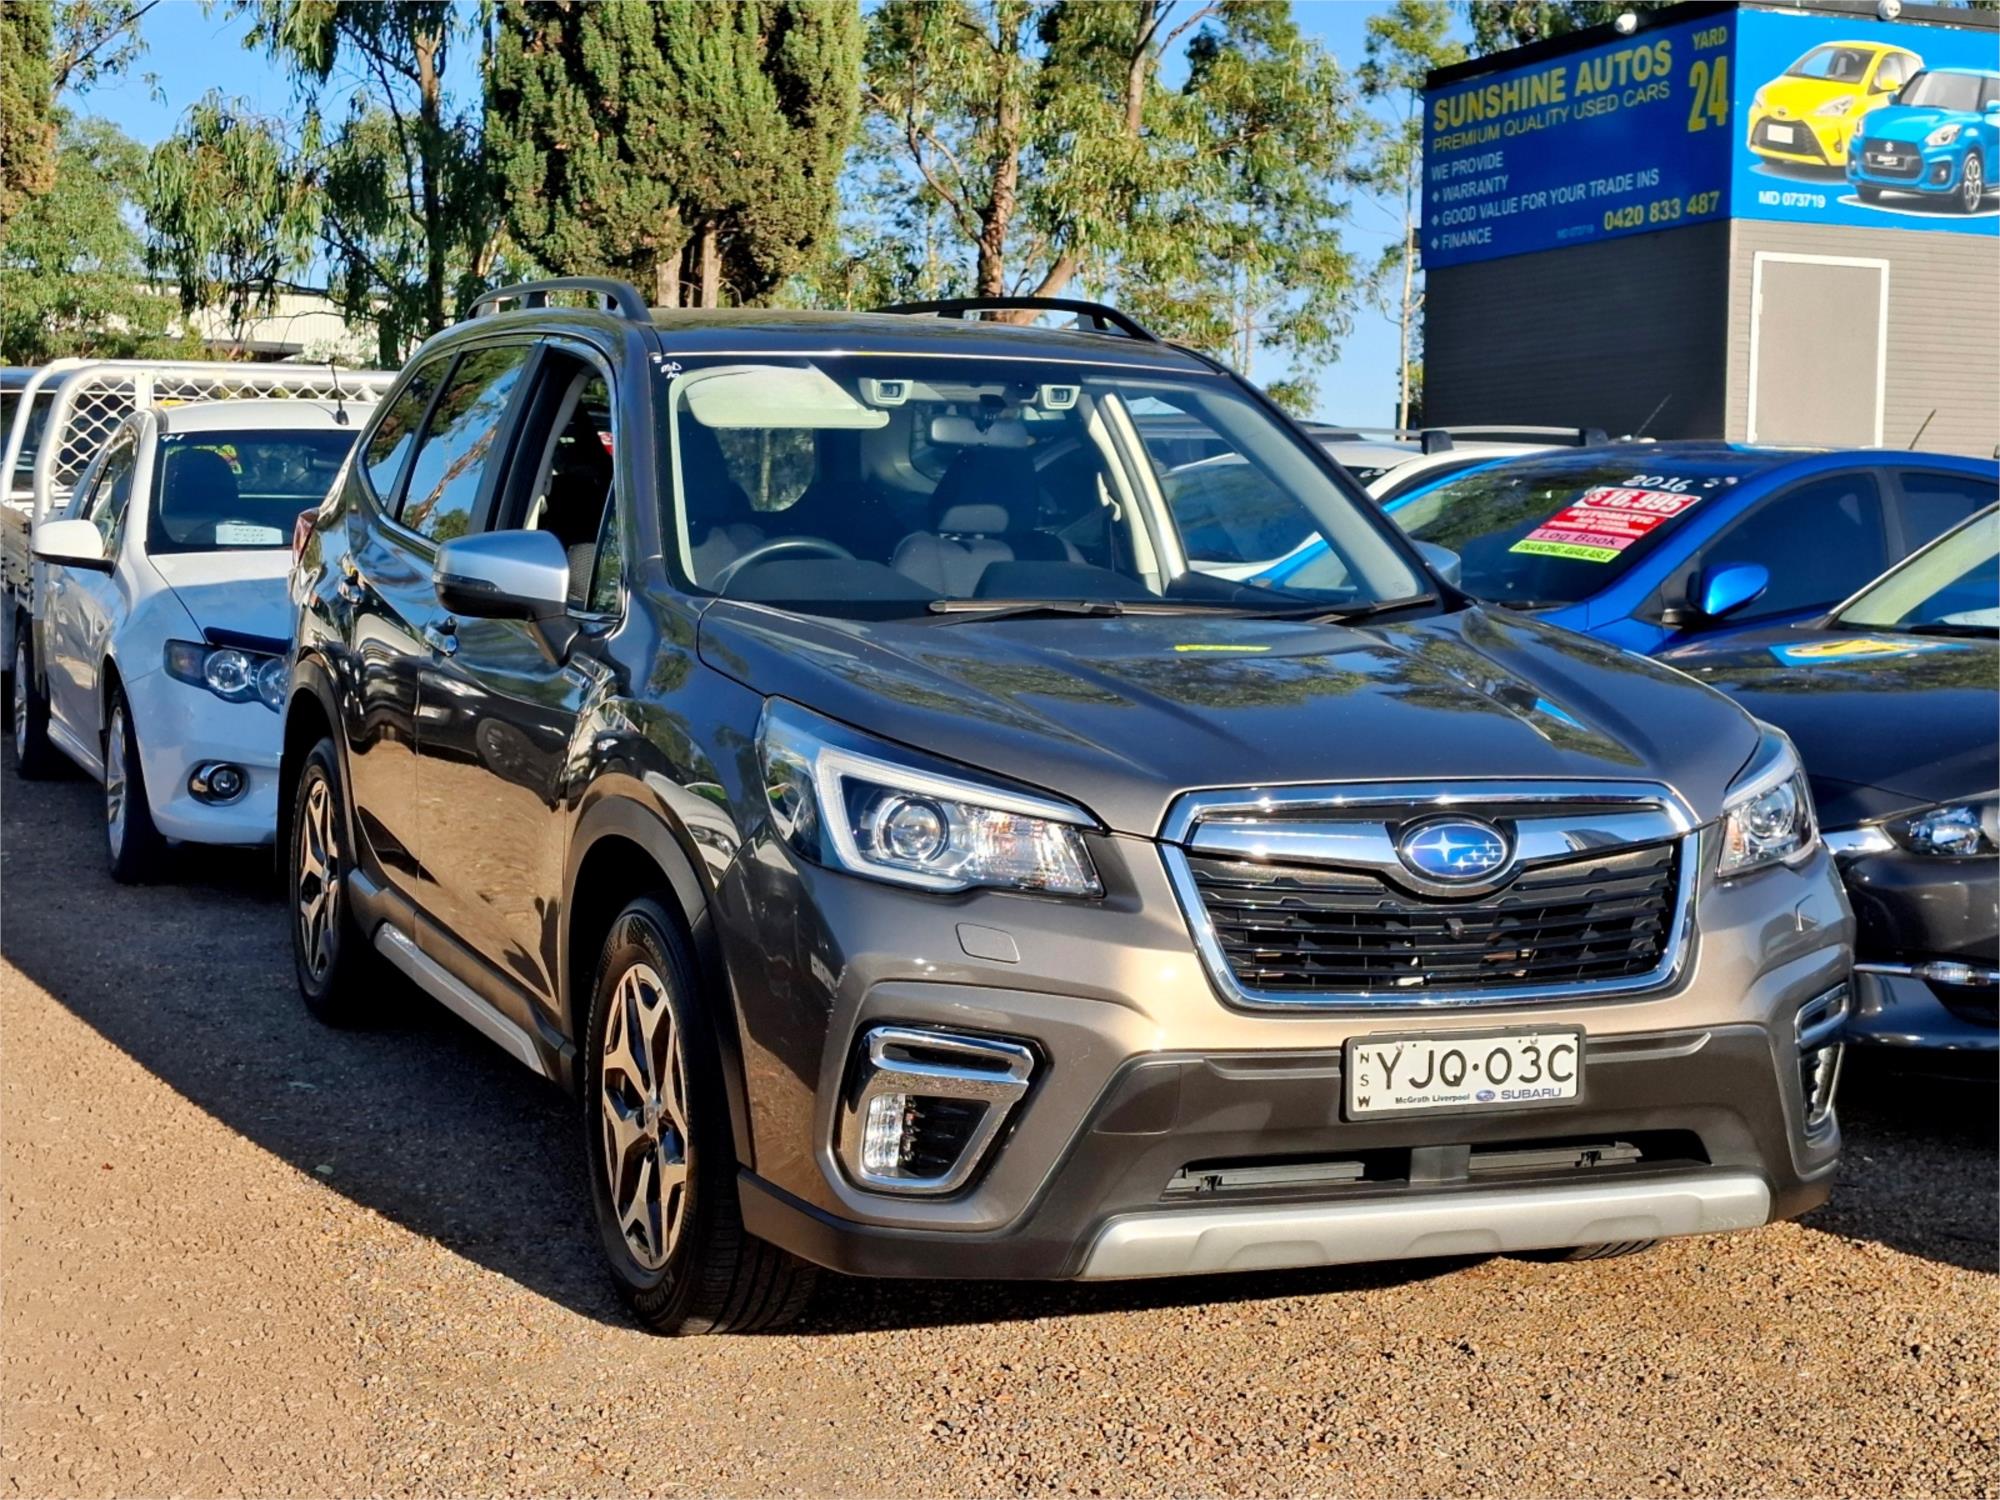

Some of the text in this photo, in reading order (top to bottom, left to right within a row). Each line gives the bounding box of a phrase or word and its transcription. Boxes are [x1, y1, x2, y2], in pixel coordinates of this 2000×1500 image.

[1692, 26, 1728, 50] YARD
[1433, 40, 1672, 132] SUNSHINE AUTOS
[1688, 56, 1729, 133] 24
[1432, 81, 1671, 153] PREMIUM QUALITY USED CARS
[1431, 151, 1504, 181] WE PROVIDE
[1442, 174, 1509, 202] WARRANTY
[1442, 168, 1660, 226] GOOD VALUE FOR YOUR TRADE INS
[1758, 191, 1826, 208] MD 073719
[1604, 190, 1721, 231] 0420 833 487
[1442, 226, 1492, 250] FINANCE
[1622, 474, 1693, 493] 2016
[1566, 508, 1656, 525] AUTOMATIC
[1539, 529, 1617, 546] Log Book
[1395, 1088, 1562, 1105] McGrath Liverpool SUBARU
